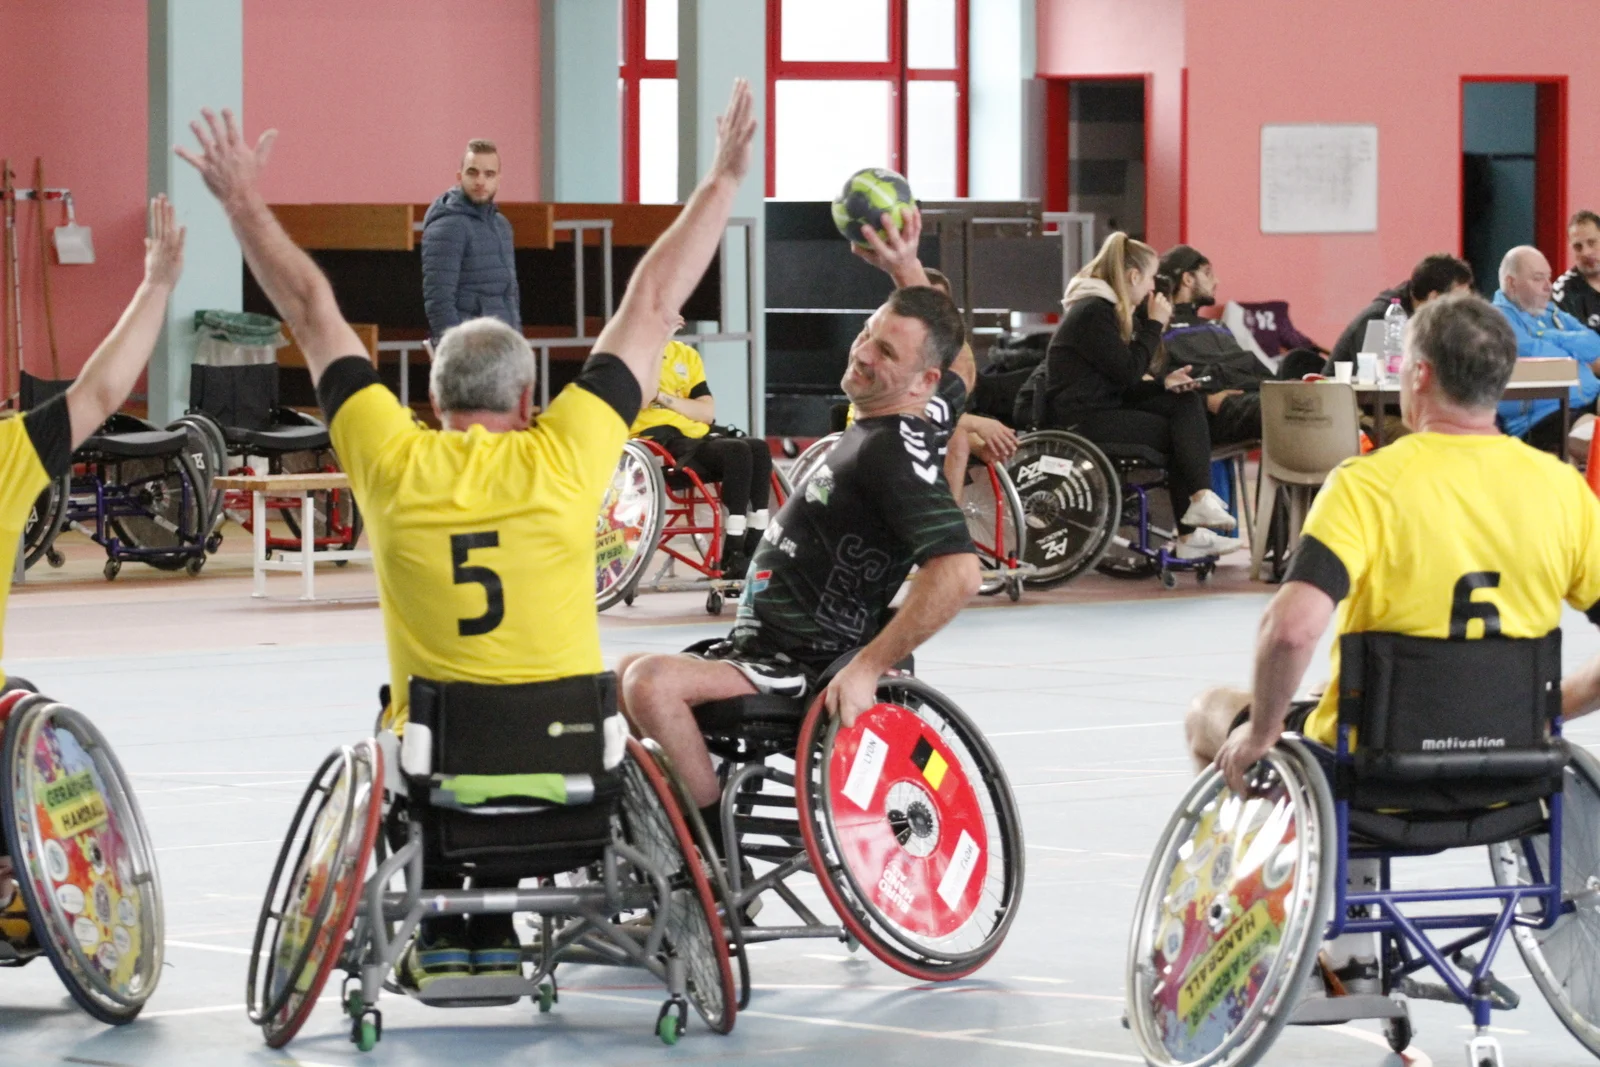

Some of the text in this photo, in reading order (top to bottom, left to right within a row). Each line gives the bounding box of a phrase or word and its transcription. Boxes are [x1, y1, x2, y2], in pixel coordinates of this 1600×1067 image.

[449, 530, 505, 637] 5
[1448, 570, 1501, 640] 6
[1421, 737, 1505, 750] motivation
[1184, 911, 1256, 999] HANDBALL
